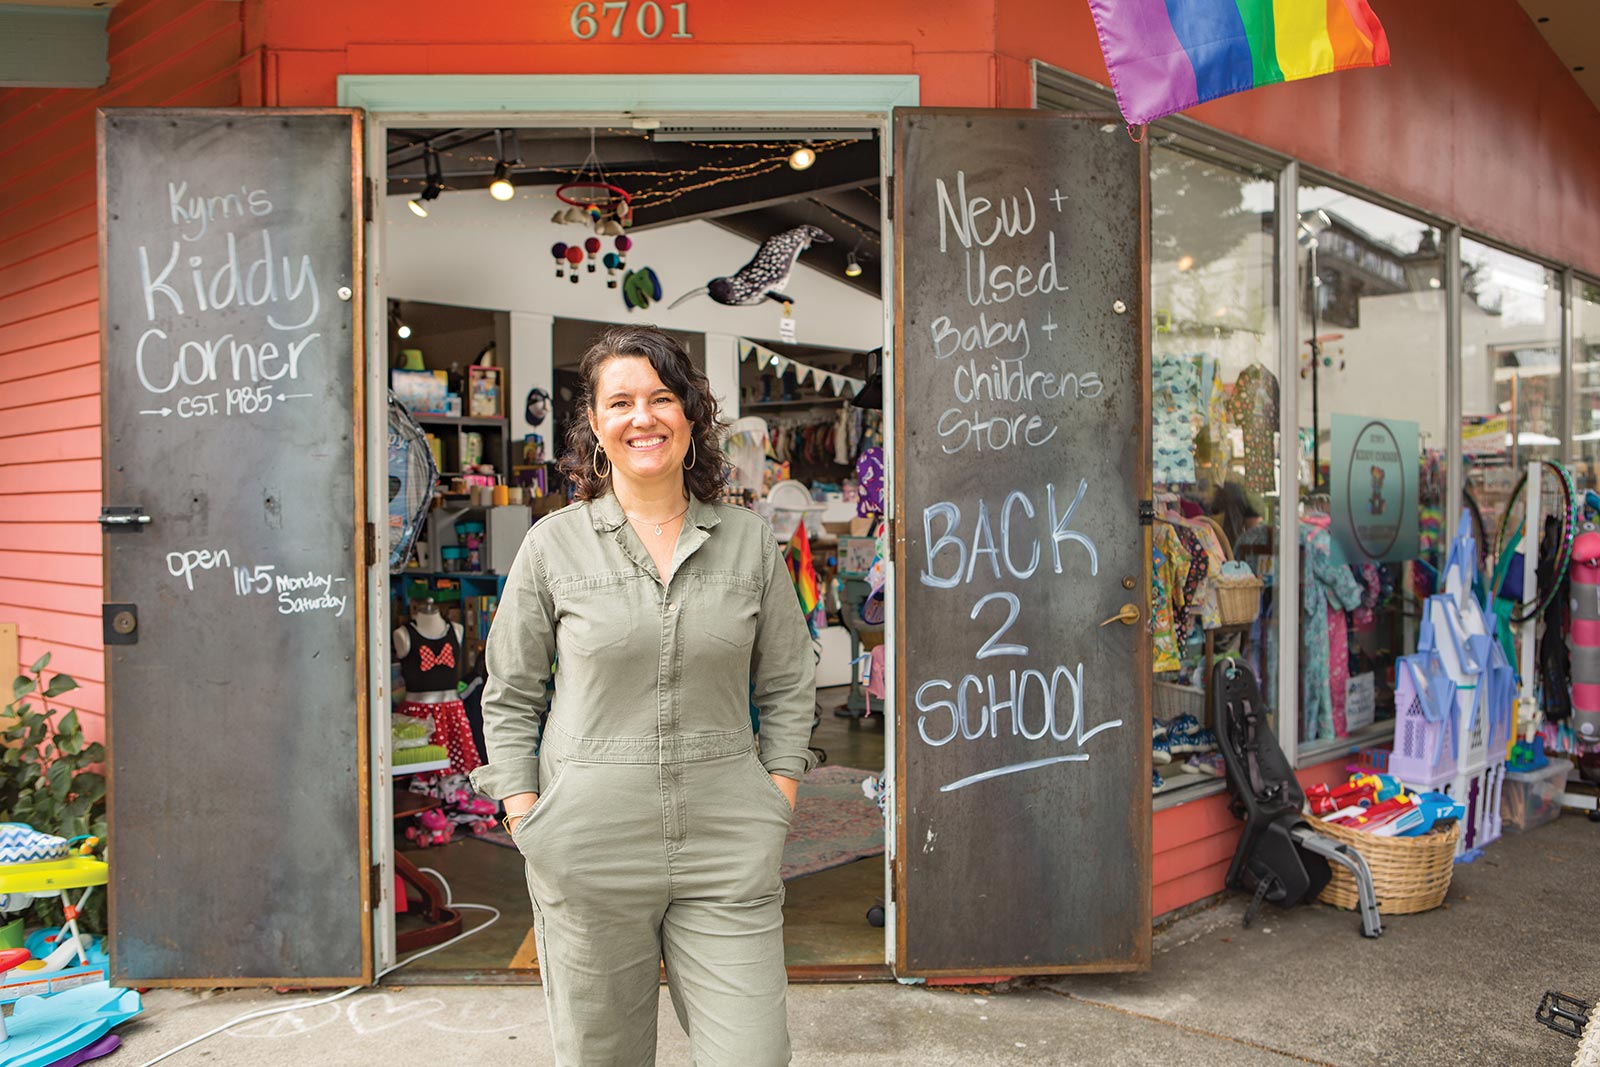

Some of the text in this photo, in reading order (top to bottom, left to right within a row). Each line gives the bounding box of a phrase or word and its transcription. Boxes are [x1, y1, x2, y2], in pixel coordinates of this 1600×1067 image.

[570, 0, 693, 39] 6701
[168, 181, 273, 241] Kym's
[936, 171, 1036, 252] New
[139, 229, 320, 330] Kiddy
[966, 231, 1069, 306] Used
[136, 329, 321, 394] Corner
[931, 312, 1030, 362] Baby
[225, 384, 274, 416] 1985
[954, 359, 1103, 403] Childrens
[937, 408, 1058, 454] Store
[920, 478, 1098, 588] BACK
[278, 592, 347, 617] Saturday
[970, 591, 1029, 660] 2
[915, 662, 1123, 746] SCHOOL
[1436, 805, 1454, 818] 17
